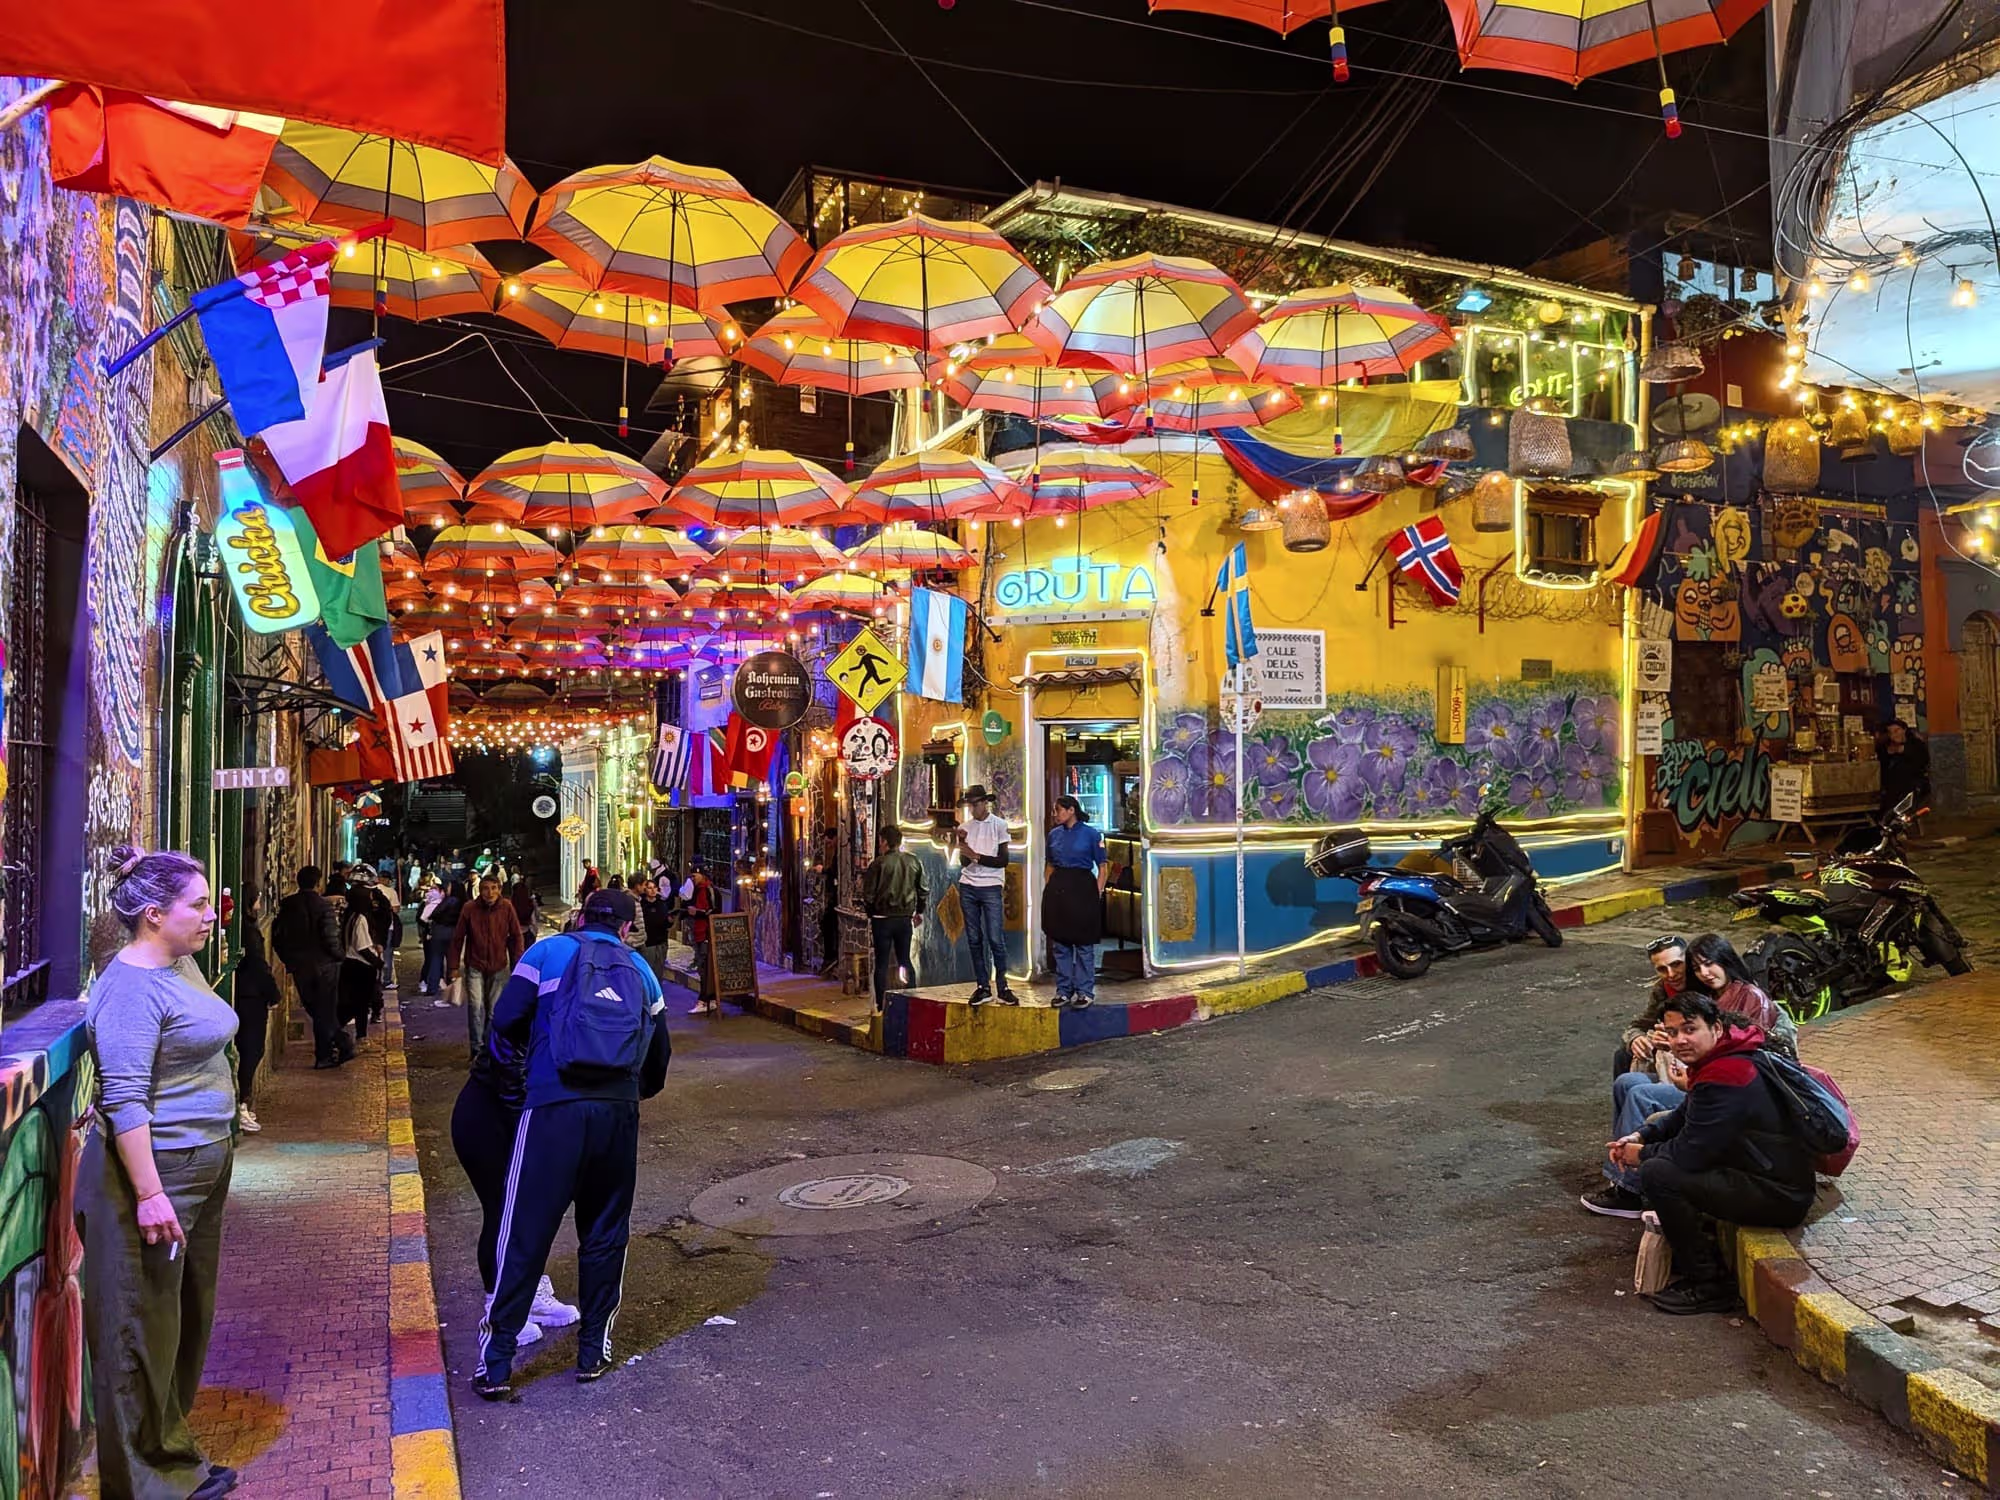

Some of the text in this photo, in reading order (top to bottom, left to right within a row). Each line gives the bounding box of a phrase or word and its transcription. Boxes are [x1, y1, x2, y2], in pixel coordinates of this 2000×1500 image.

[227, 499, 301, 619] Chicha
[995, 559, 1158, 609] GRUTA
[1266, 647, 1296, 656] CALLE
[1266, 659, 1298, 669] DE LAS
[746, 670, 800, 686] Bohemian
[1261, 671, 1304, 680] VIOLETAS
[849, 732, 889, 763] 20
[215, 768, 286, 788] TiNTO
[1656, 760, 1682, 790] DEL
